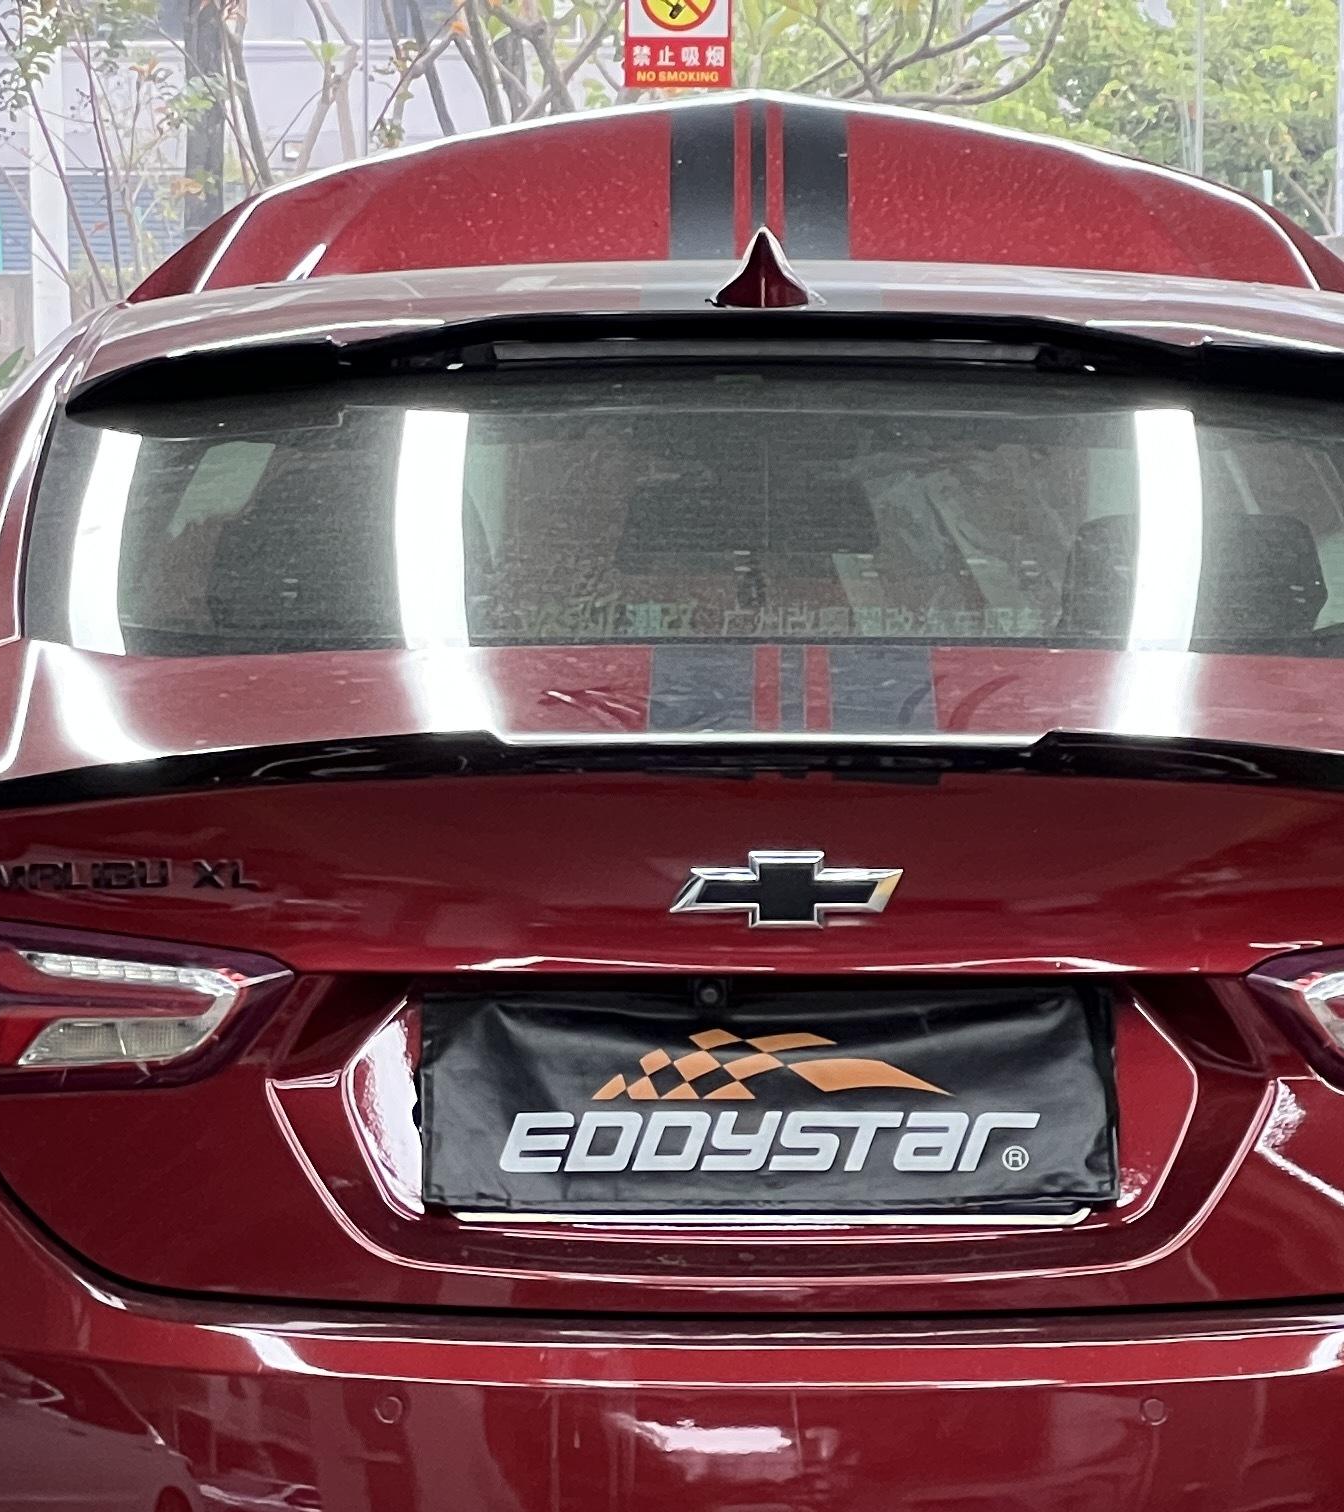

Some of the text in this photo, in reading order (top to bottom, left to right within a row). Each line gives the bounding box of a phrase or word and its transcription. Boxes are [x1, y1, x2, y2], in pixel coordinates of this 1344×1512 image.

[632, 45, 725, 67] 禁止吸烟
[636, 71, 719, 82] NO SMOKING
[192, 857, 262, 890] XL
[498, 1110, 1041, 1173] EDDYSTAR
